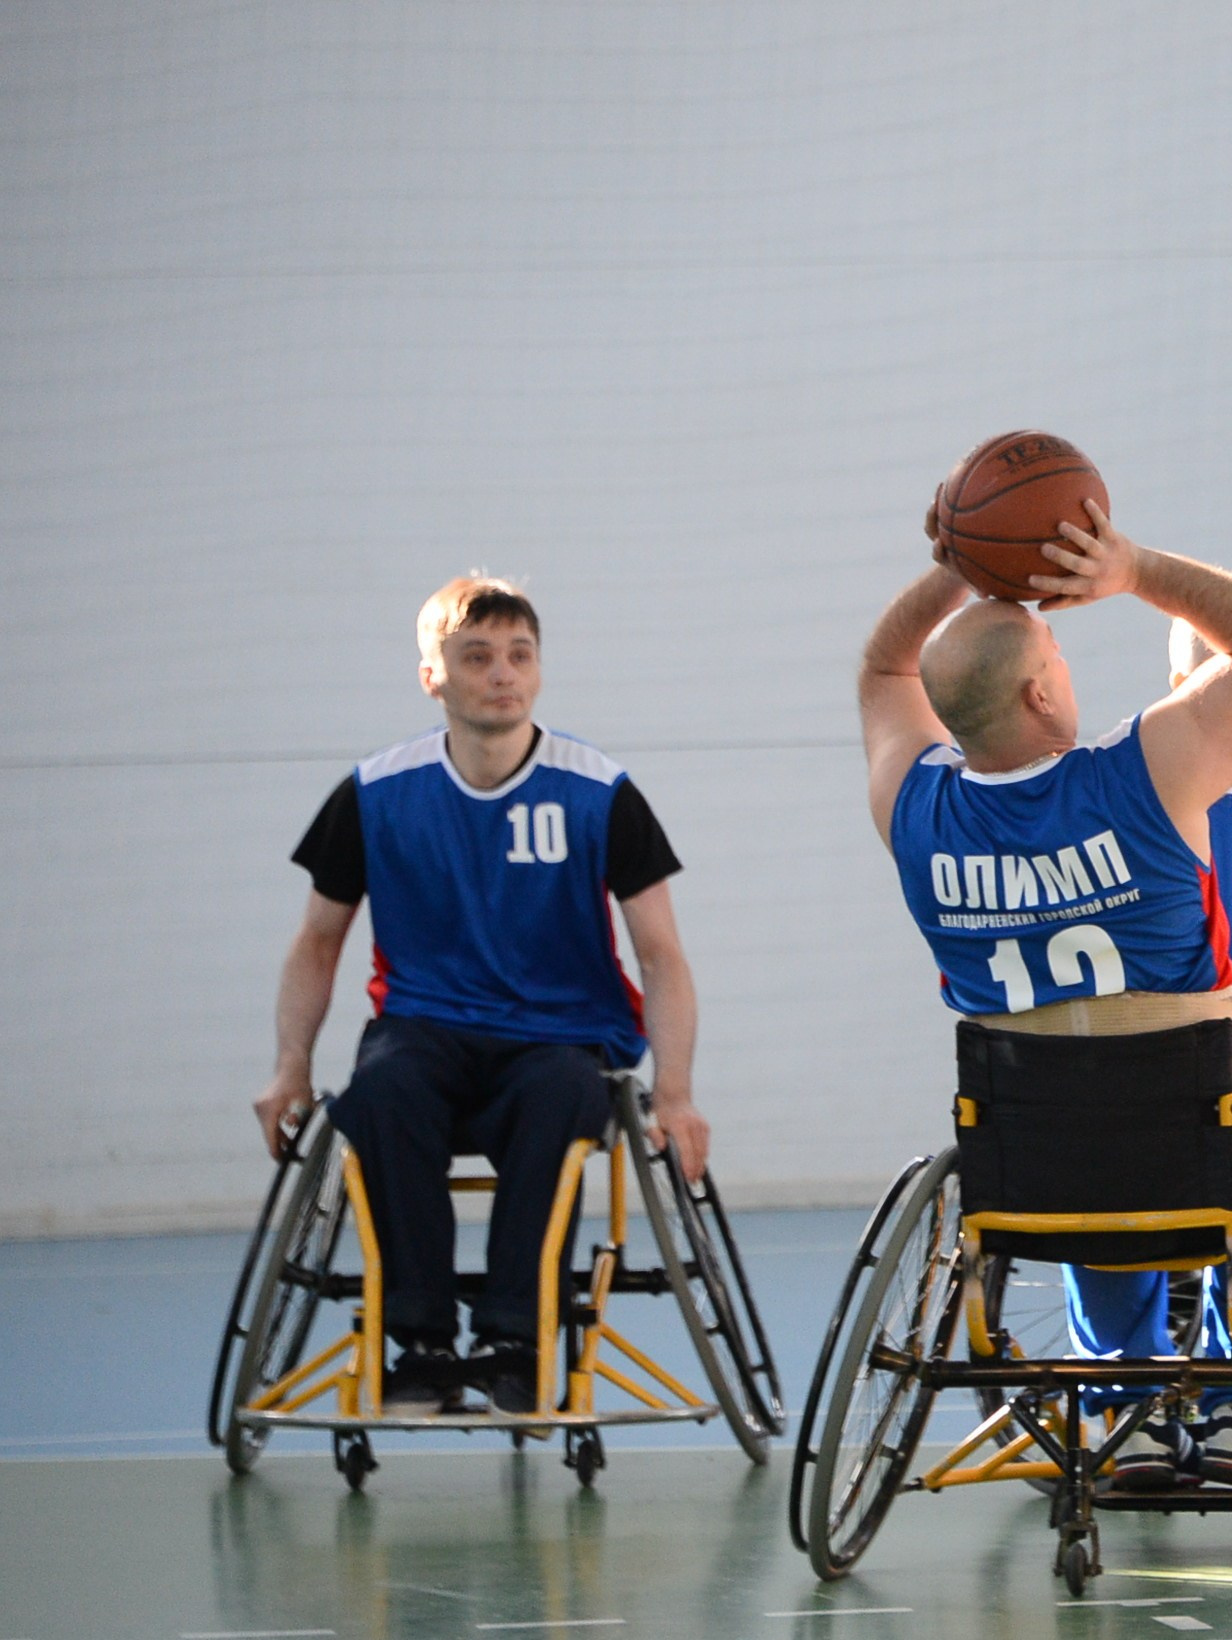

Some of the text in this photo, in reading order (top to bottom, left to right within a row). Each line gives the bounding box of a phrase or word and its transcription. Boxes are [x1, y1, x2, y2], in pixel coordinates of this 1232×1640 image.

[506, 802, 569, 864] 10
[930, 829, 1132, 910] ОЛИМП
[1039, 898, 1104, 922] ГОРОДСКОЙ
[1105, 888, 1140, 909] ОКРУГ
